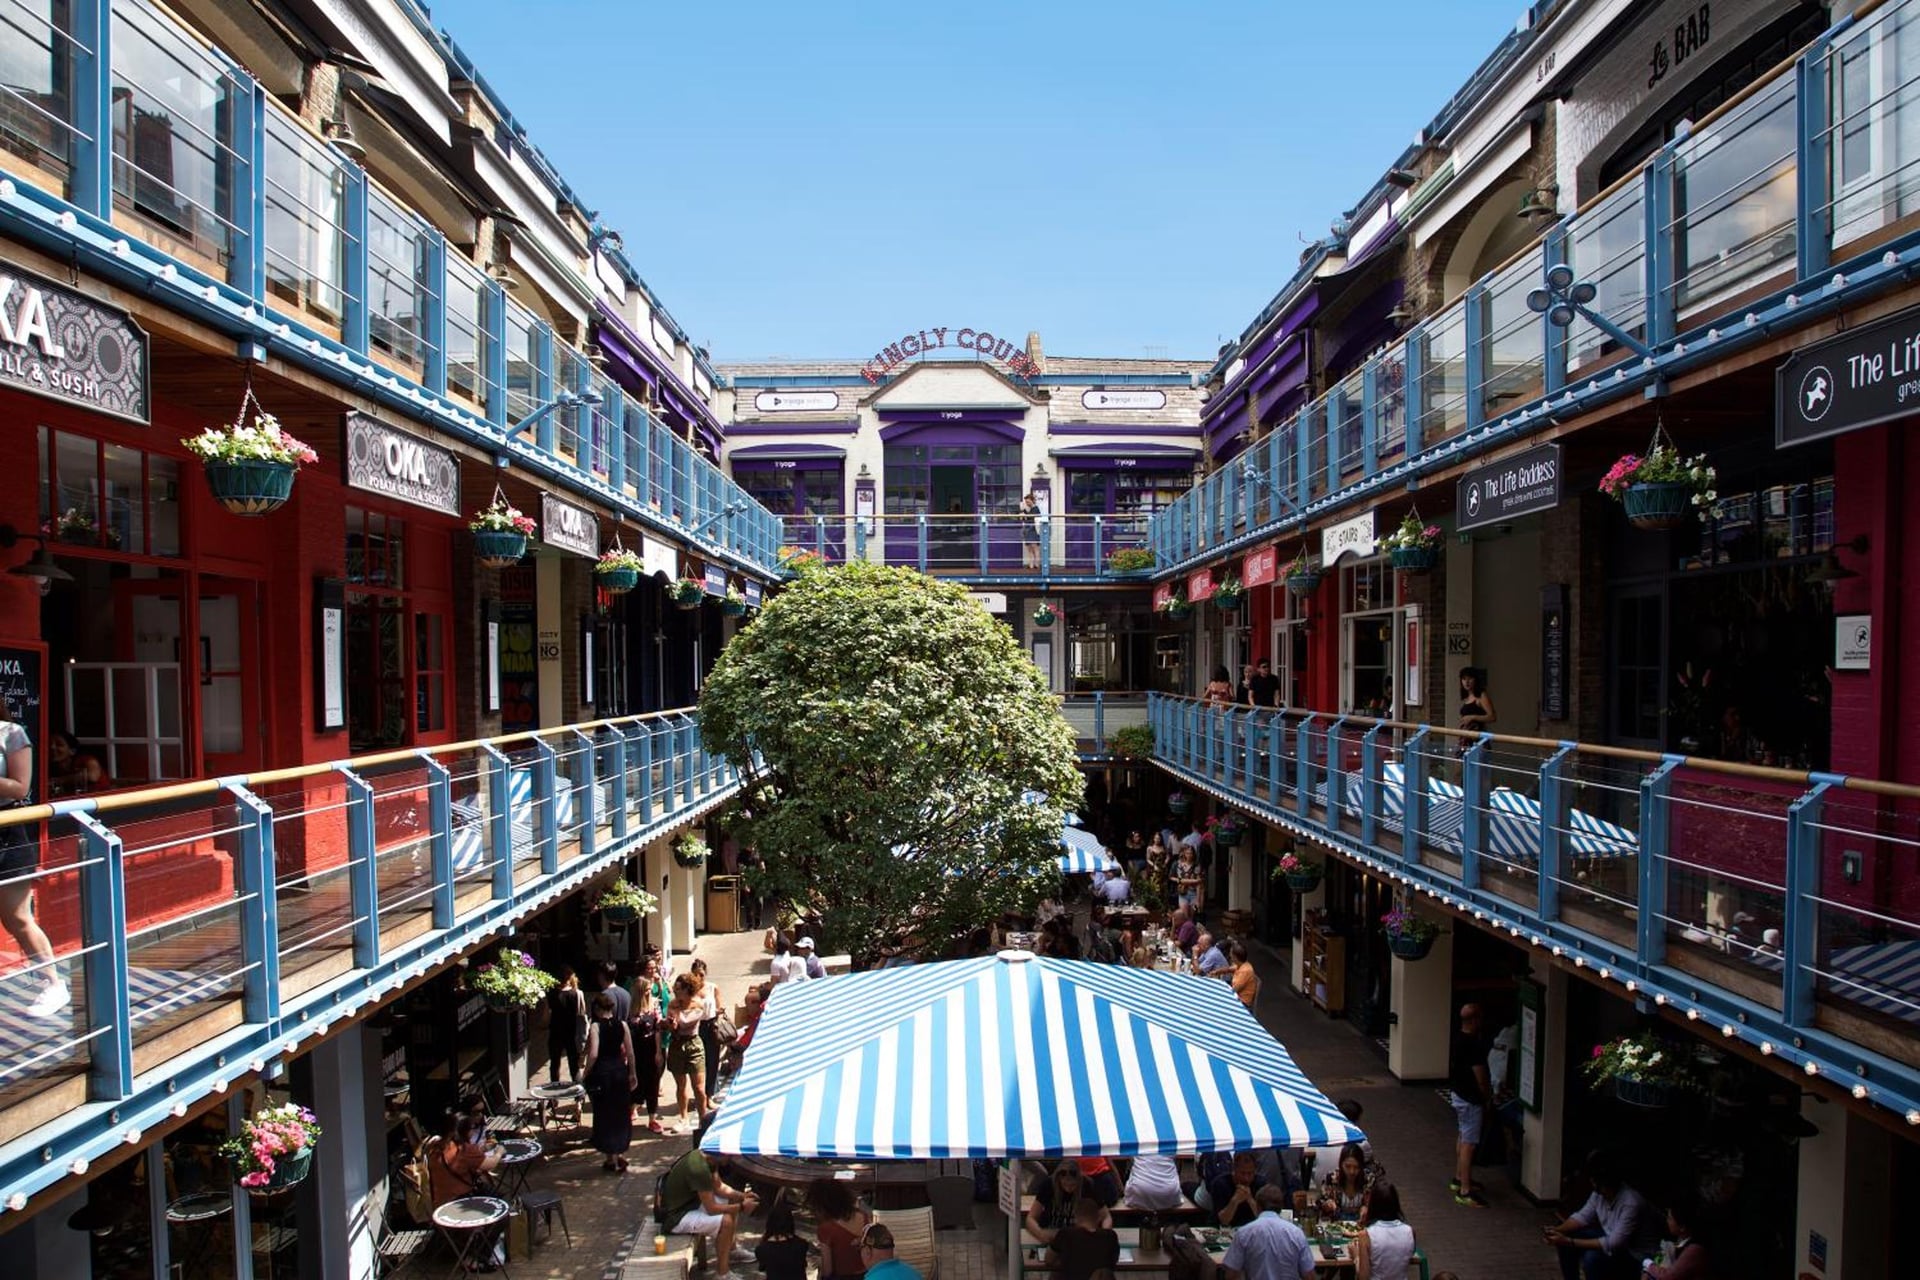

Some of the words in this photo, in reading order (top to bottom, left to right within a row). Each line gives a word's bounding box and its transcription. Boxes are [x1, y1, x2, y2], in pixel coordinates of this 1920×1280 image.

[1648, 41, 1670, 90] Le
[1674, 3, 1710, 66] BAB
[860, 327, 947, 384] KINGLY
[957, 328, 1042, 380] COURT
[1847, 353, 1884, 389] The
[32, 363, 43, 383] &
[51, 369, 99, 399] SUSHI
[383, 436, 431, 486] OKA.
[1484, 479, 1499, 499] The
[1499, 470, 1517, 495] Life
[1518, 460, 1556, 489] Goddess
[540, 645, 560, 658] NO
[1449, 638, 1471, 651] NO
